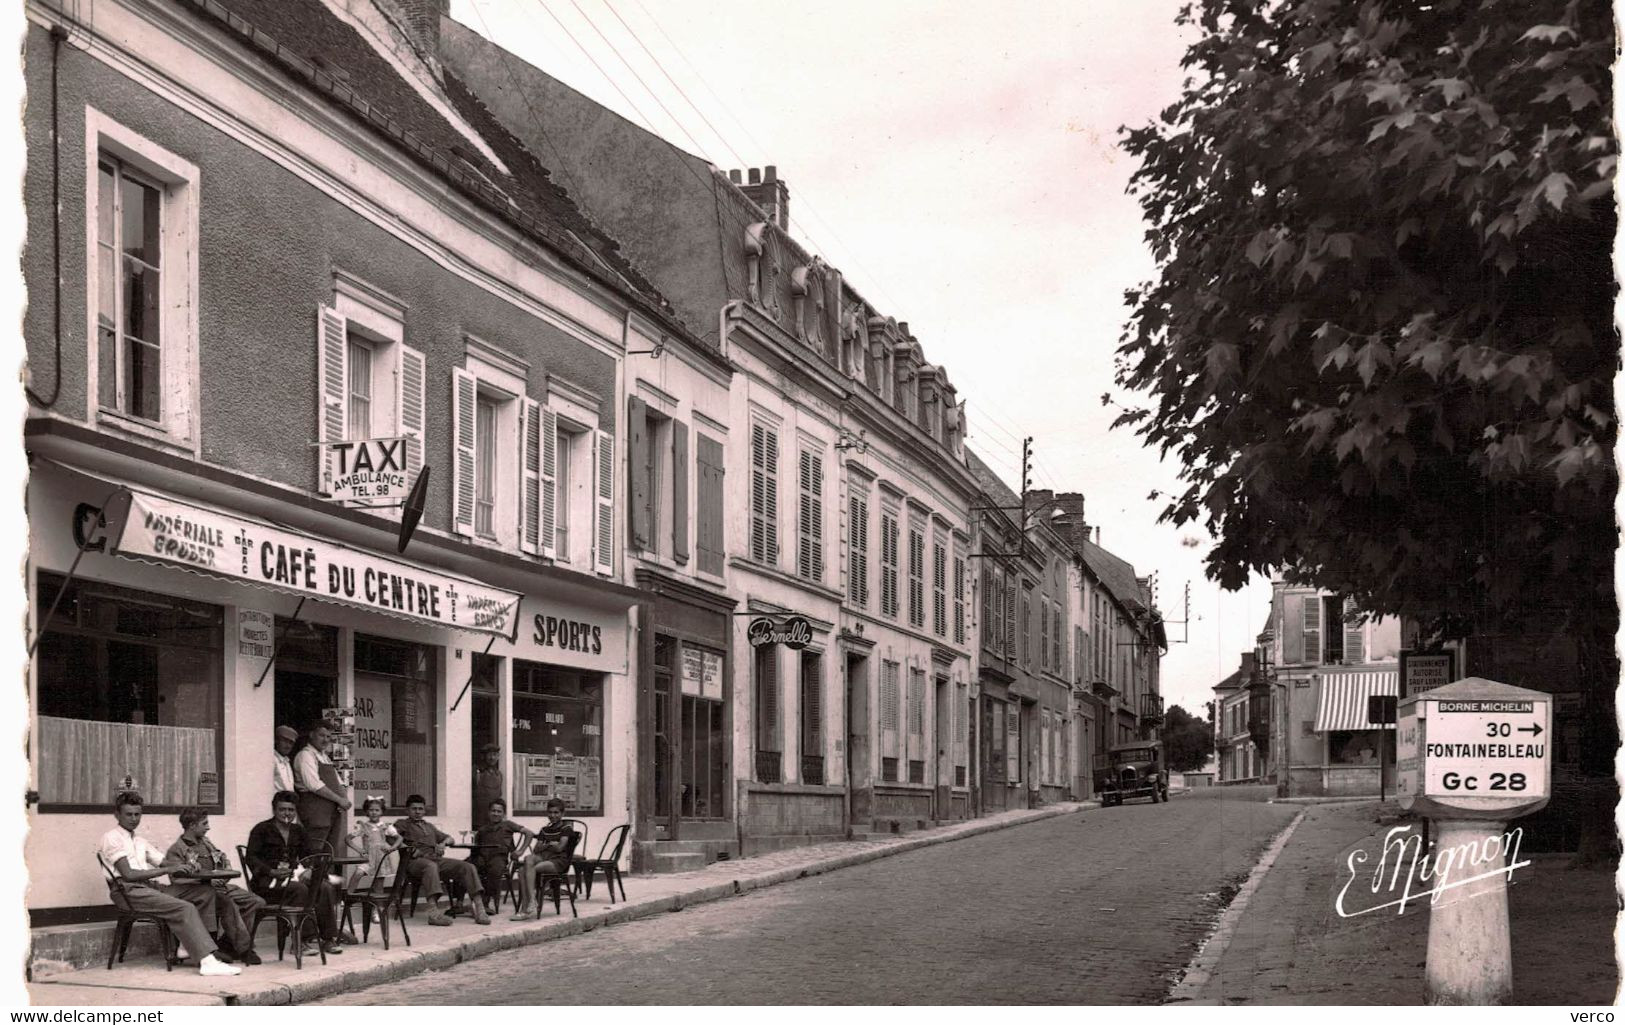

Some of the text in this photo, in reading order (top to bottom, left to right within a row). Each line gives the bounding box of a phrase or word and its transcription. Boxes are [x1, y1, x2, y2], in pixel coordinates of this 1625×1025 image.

[332, 439, 407, 475] TAXI
[333, 472, 405, 493] AMBULANCE
[260, 540, 441, 618] CAFÉ DU CENTRE
[533, 613, 602, 655] SPORTS
[354, 697, 374, 719] BAR
[1440, 702, 1533, 712] BORNE MICHELIN
[356, 728, 389, 750] TABAC
[1486, 722, 1511, 737] 30
[1426, 743, 1544, 759] FONTAINEBLEAU
[1442, 772, 1527, 791] Gc 28
